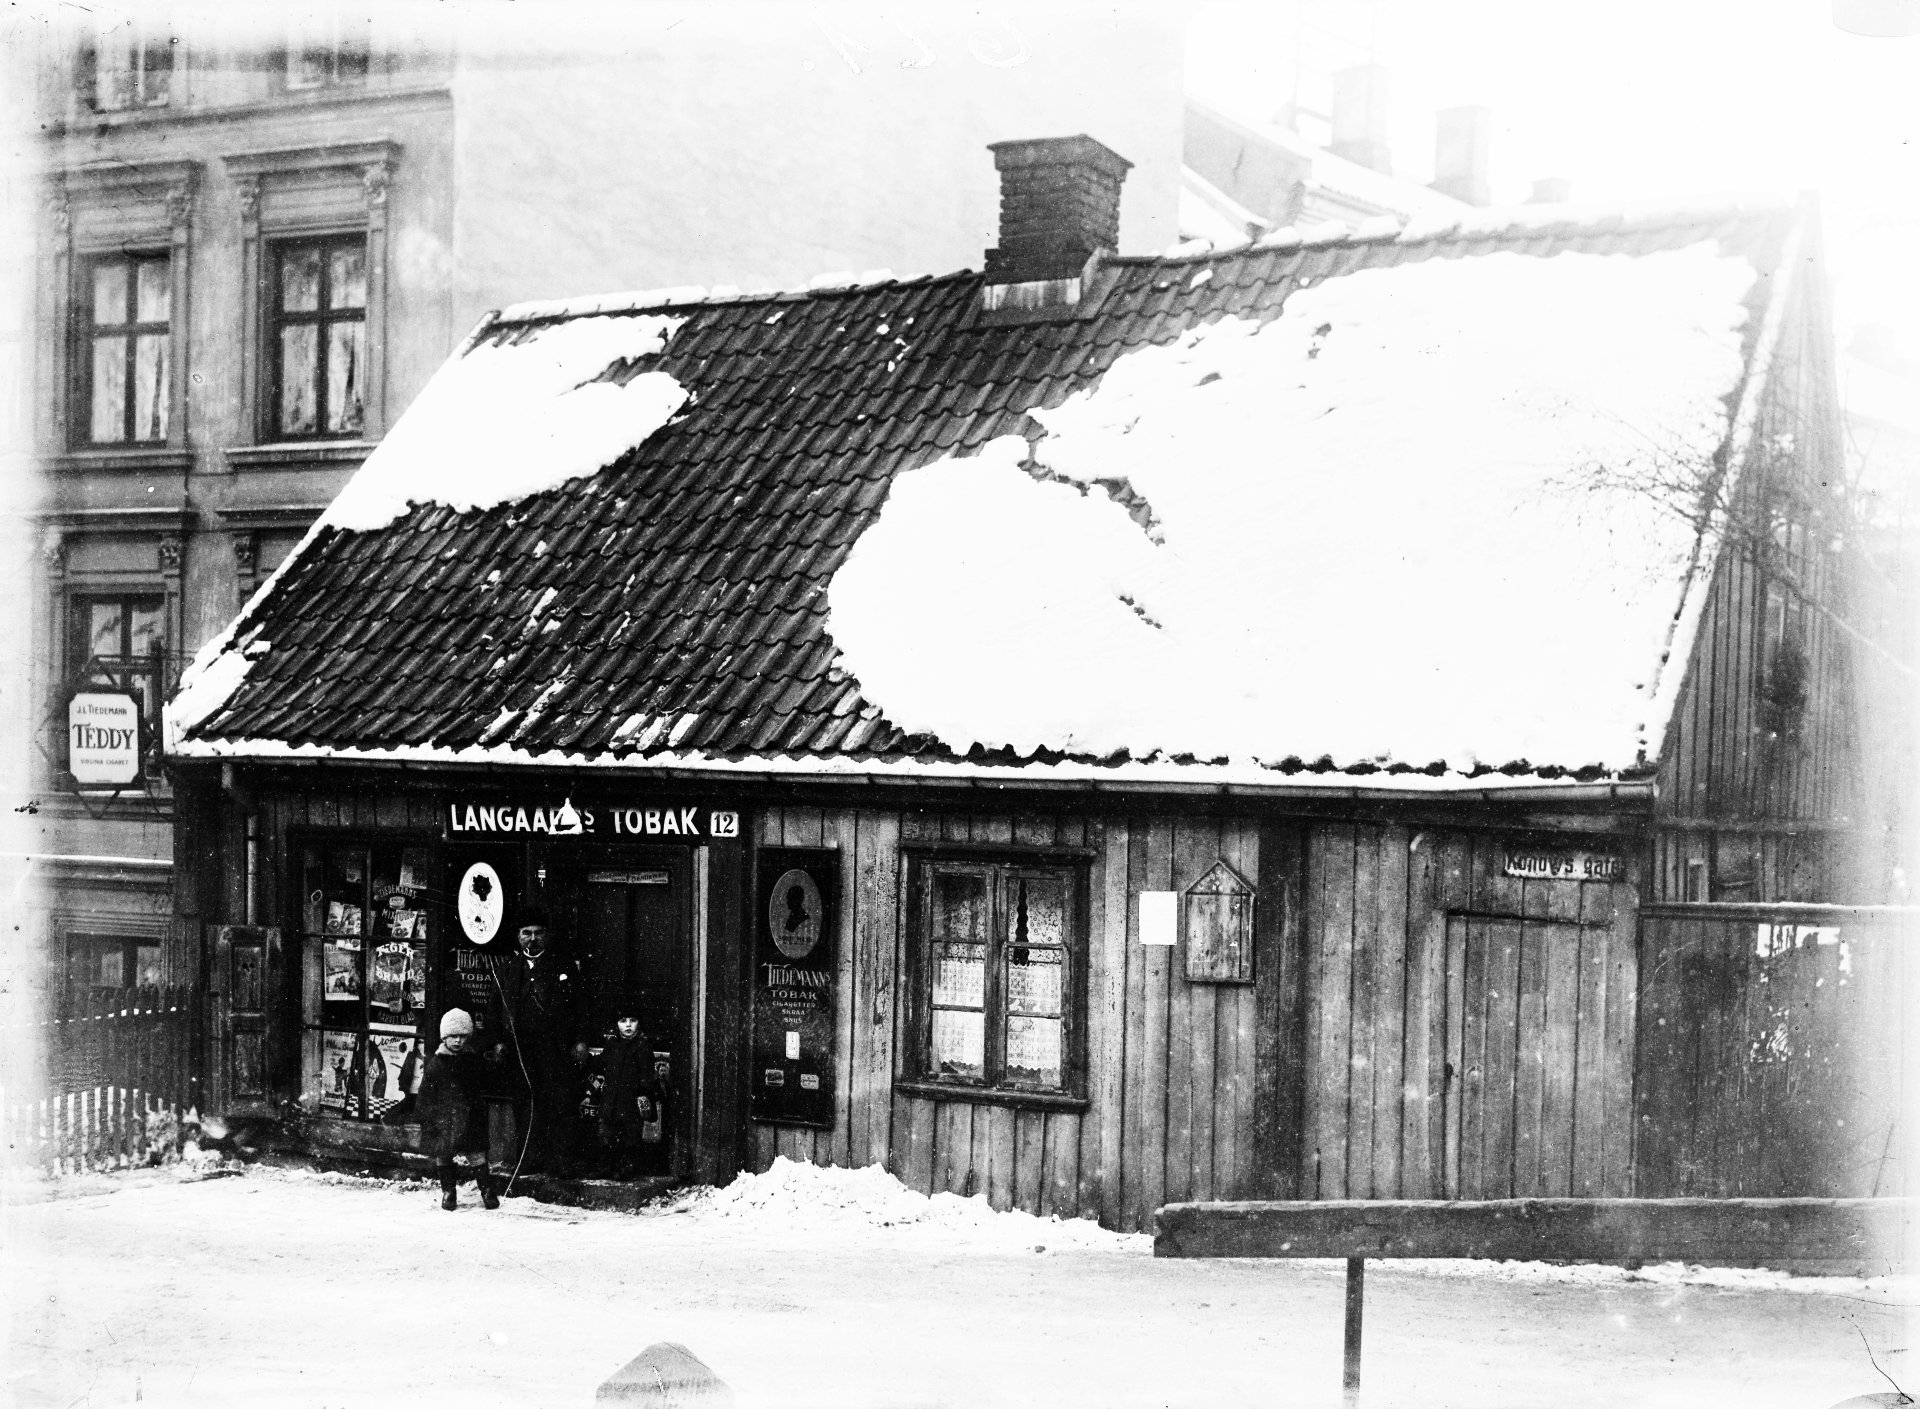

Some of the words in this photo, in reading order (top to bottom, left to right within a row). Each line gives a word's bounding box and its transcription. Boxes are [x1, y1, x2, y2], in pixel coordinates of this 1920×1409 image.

[87, 703, 127, 715] TIEDEMANN
[72, 722, 134, 750] TEDDY
[610, 806, 700, 836] TOBAK
[714, 814, 735, 834] 12
[376, 965, 415, 983] BRAND
[460, 972, 492, 982] TOBA
[760, 962, 831, 987] TIEDEMANNS
[770, 989, 818, 1000] TOBAK
